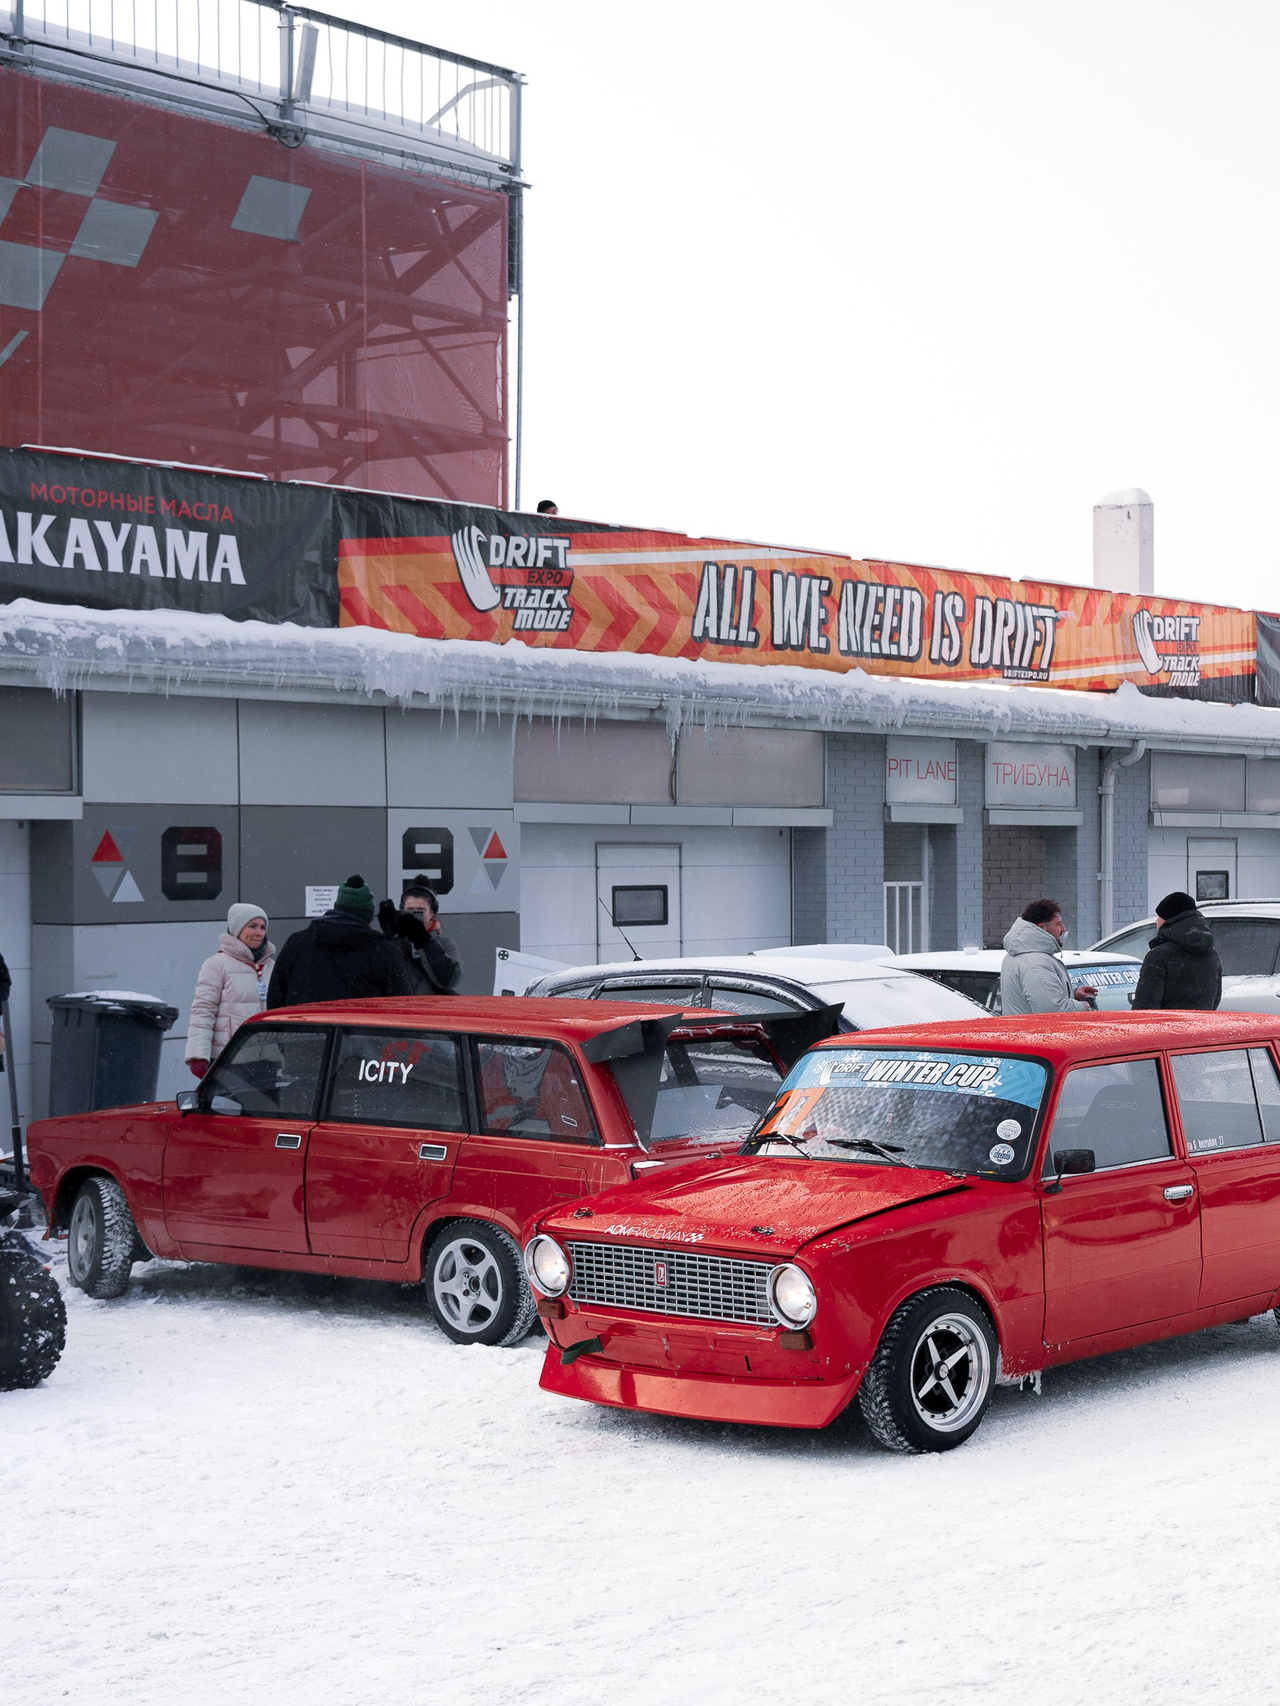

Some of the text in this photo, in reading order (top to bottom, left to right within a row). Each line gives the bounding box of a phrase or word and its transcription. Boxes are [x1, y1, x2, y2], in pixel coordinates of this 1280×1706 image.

[30, 481, 235, 523] МОТОРНЫЕ МАСЛА
[488, 535, 571, 569] DRIFT
[527, 569, 564, 585] EXPO
[503, 586, 569, 610] TRACK
[513, 608, 572, 630] MODE
[693, 562, 1057, 669] ALL WE NEED IS DRIFT
[1153, 617, 1199, 642] DRIFT
[1003, 669, 1048, 680] DRIFTEXPO.RU
[1168, 672, 1200, 687] MODE
[887, 758, 956, 781] PIT LANE
[992, 762, 1071, 788] ТРИБУНА
[161, 826, 223, 901] 8
[402, 826, 454, 896] 9
[1083, 970, 1126, 987] WINTER
[358, 1059, 414, 1085] ICITY
[832, 1059, 997, 1088] DRIFT WINTER CUP
[757, 1087, 827, 1136] 27
